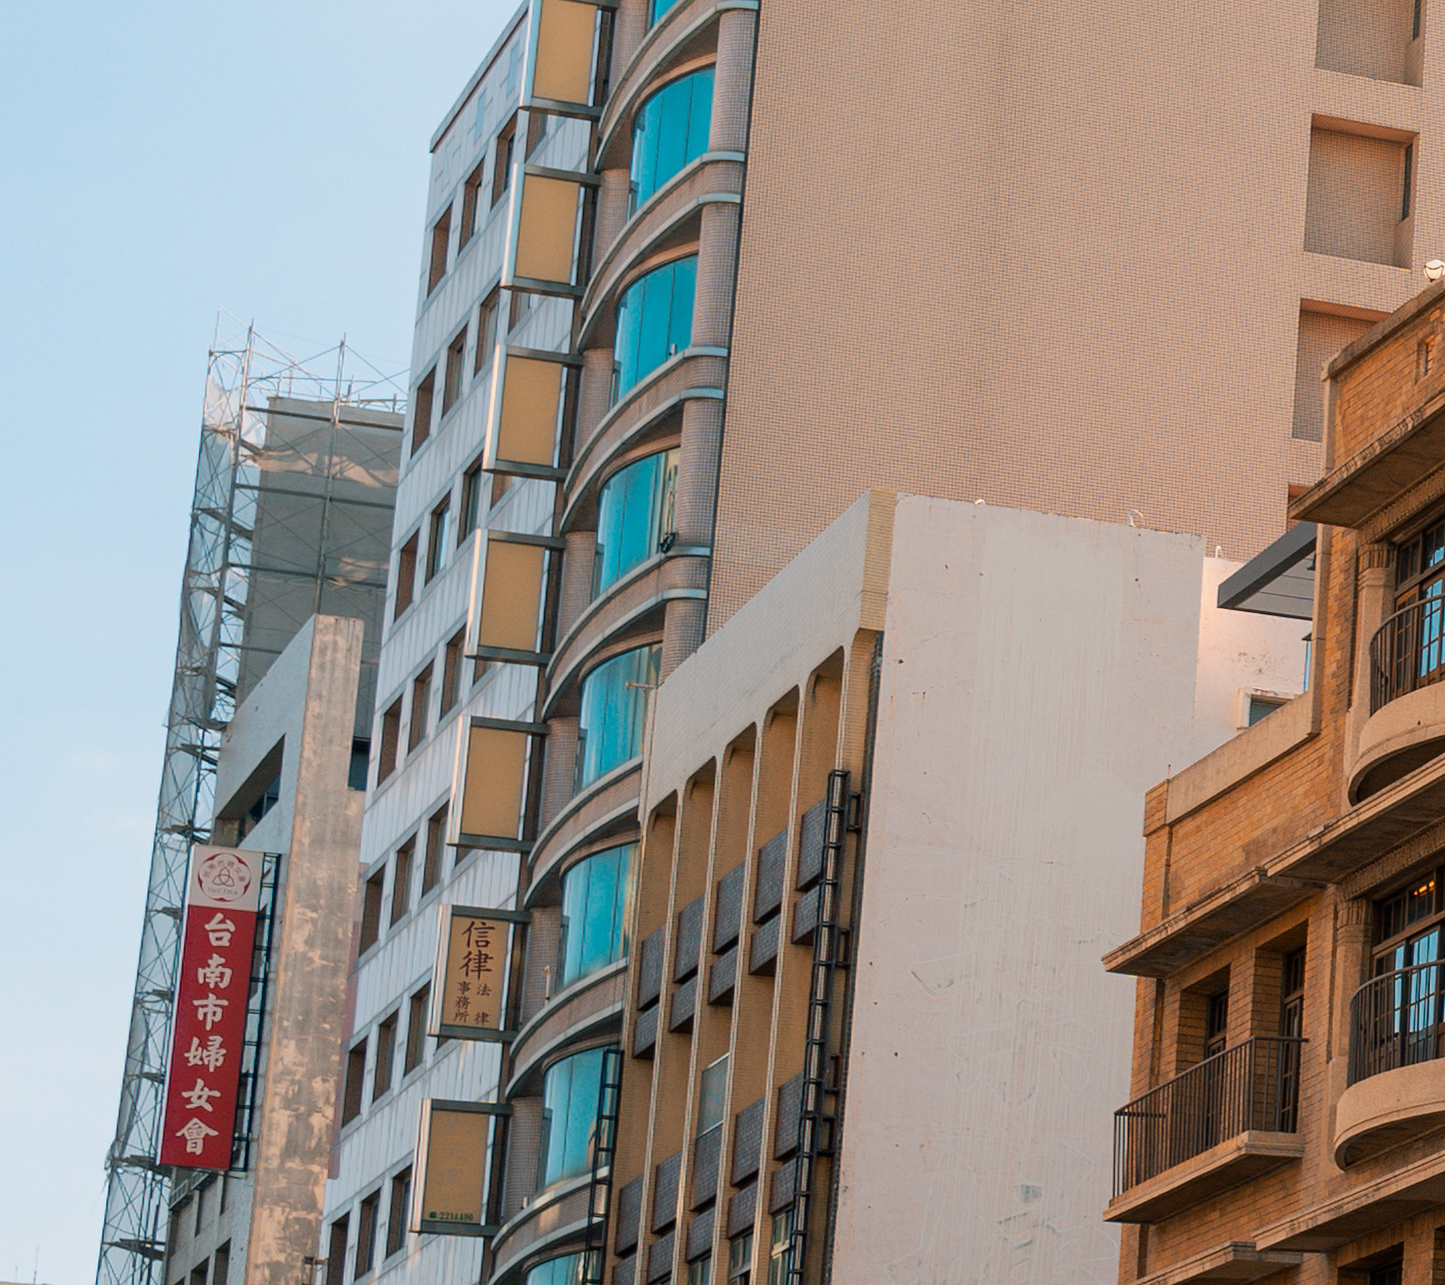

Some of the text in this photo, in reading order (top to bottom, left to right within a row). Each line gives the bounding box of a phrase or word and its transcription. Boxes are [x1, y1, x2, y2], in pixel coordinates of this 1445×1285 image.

[459, 920, 496, 981] 信律
[175, 912, 236, 1156] 台南市婦女會
